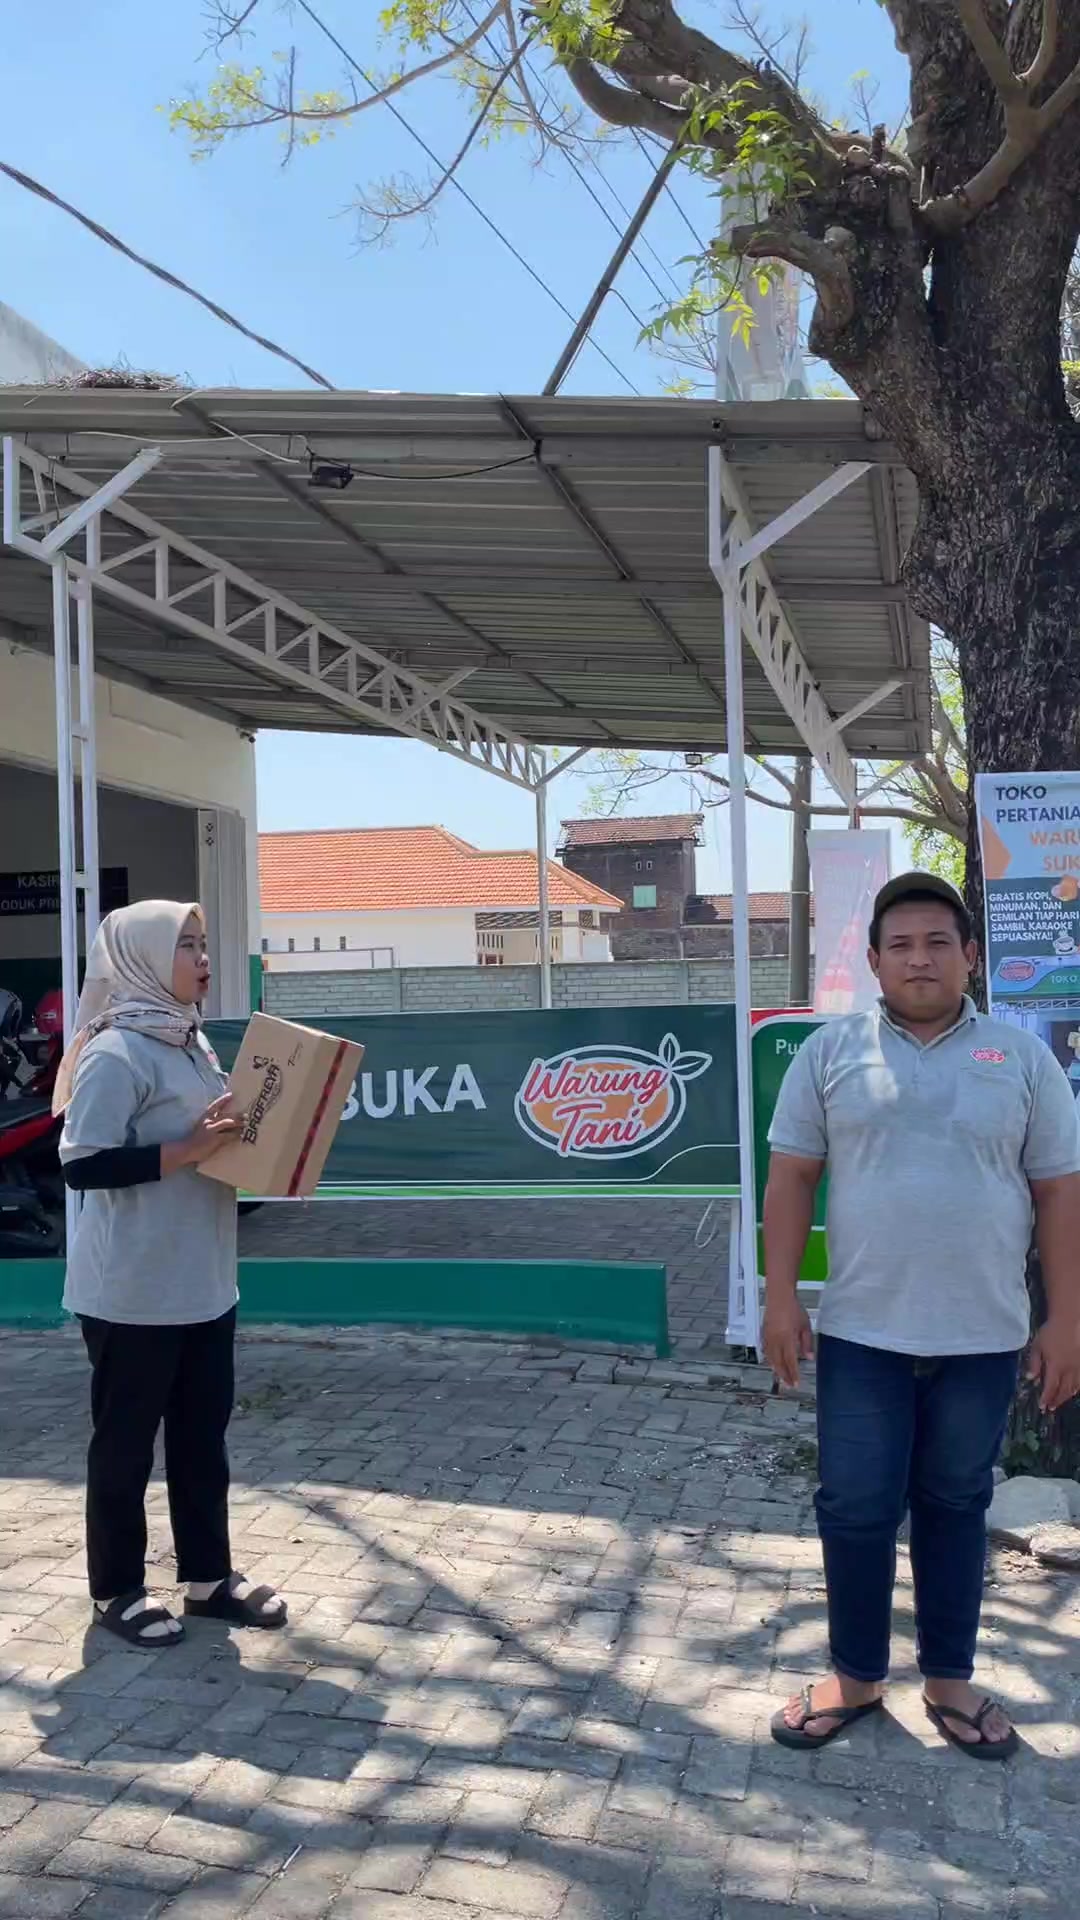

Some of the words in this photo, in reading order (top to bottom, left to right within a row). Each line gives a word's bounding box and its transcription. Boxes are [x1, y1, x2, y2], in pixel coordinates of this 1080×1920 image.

[995, 785, 1047, 801] TOKO
[996, 806, 1080, 823] PERTANIA
[1029, 829, 1080, 848] WAR
[989, 892, 1024, 901] GRATIS
[1043, 901, 1062, 910] DAN
[990, 911, 1033, 921] CEMILAN
[1035, 911, 1054, 920] TIAP
[1056, 910, 1080, 919] HARI
[991, 921, 1026, 931] SAMBIL
[1028, 921, 1073, 930] KARAOKE
[523, 1059, 669, 1106] Warung
[555, 1102, 643, 1153] Tani
